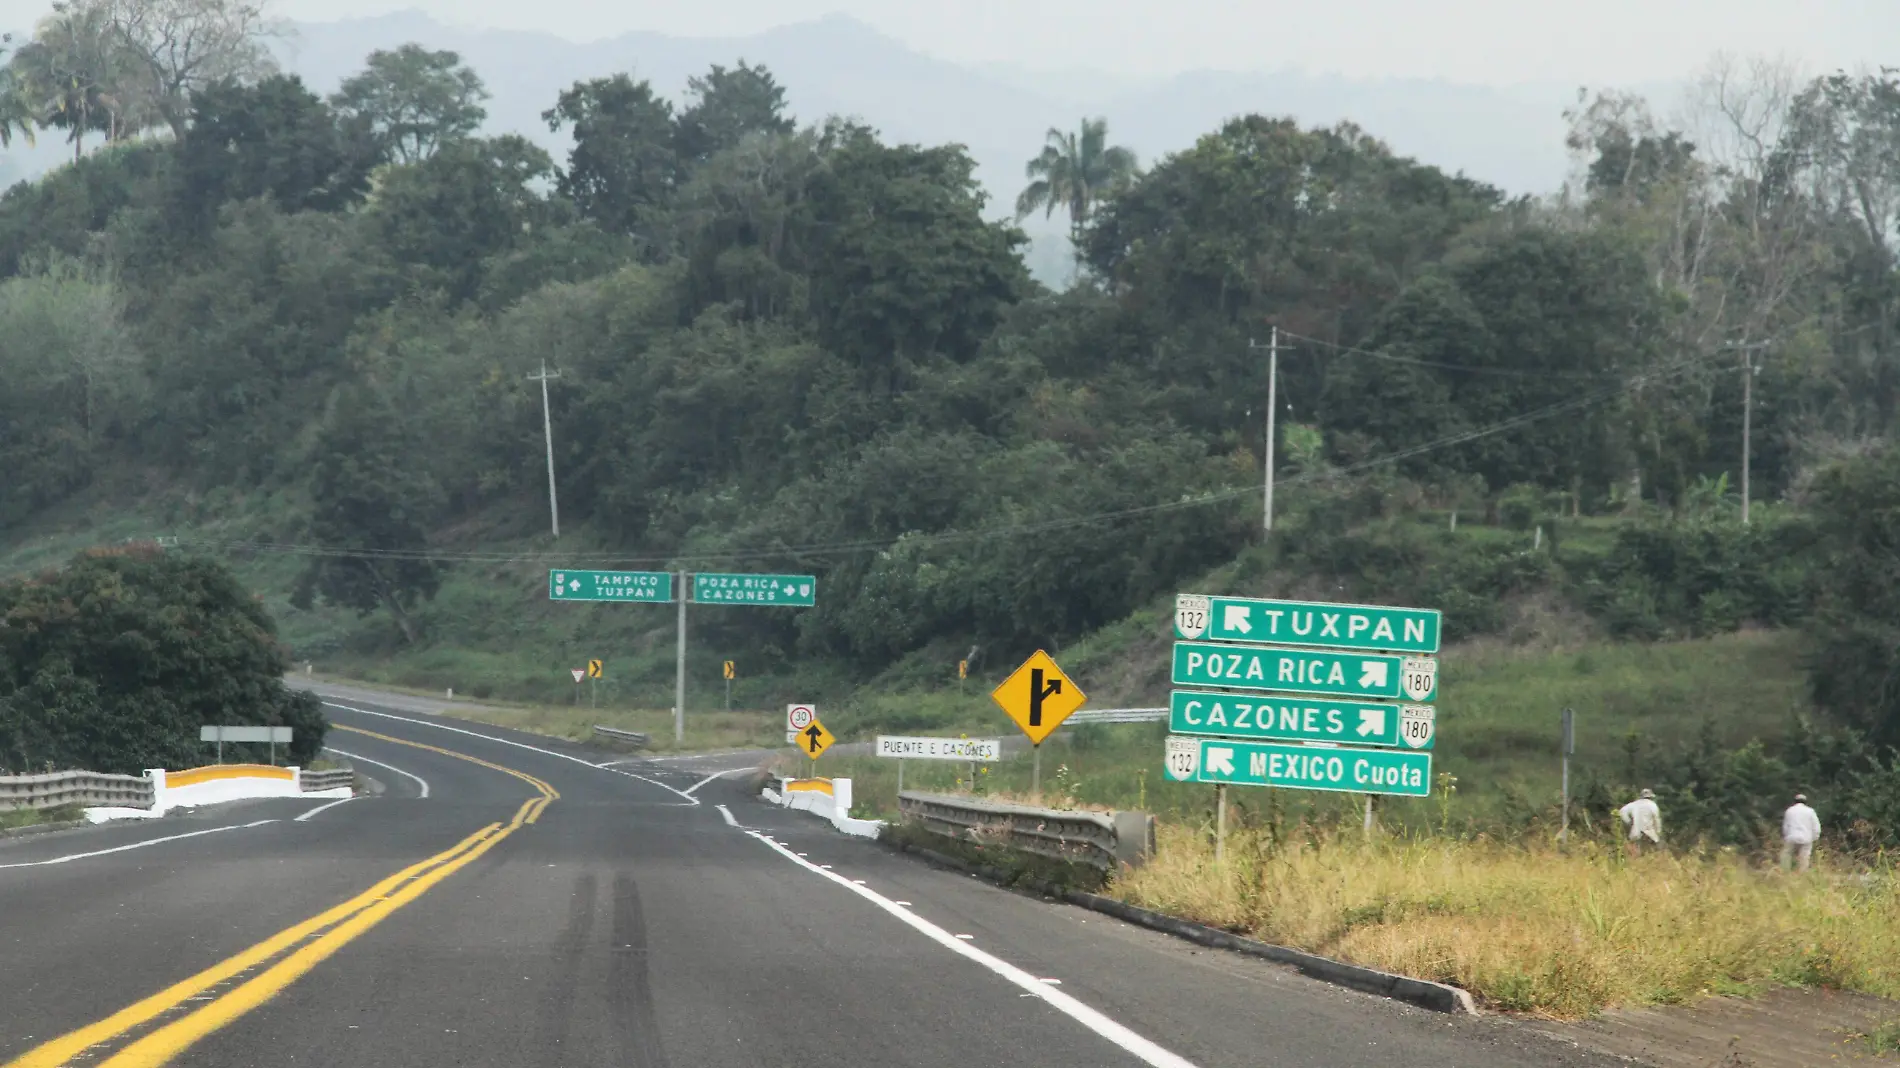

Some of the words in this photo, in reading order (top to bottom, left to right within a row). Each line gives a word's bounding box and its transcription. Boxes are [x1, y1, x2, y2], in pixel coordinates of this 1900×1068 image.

[594, 575, 658, 586] TAMPICO
[699, 577, 739, 588] POZA
[744, 578, 779, 589] RICA
[596, 587, 656, 597] TUXPAN
[702, 590, 775, 600] CAZONES
[1180, 611, 1203, 629] 132
[1265, 610, 1425, 643] TUXPAN
[1187, 652, 1264, 680] POZA
[1278, 658, 1346, 686] RICA
[1408, 674, 1431, 692] 180
[795, 711, 807, 721] 30
[1184, 700, 1344, 734] CAZONES
[1405, 709, 1432, 717] MEXICO
[1406, 721, 1428, 739] 180
[883, 741, 924, 754] PUENTE
[1172, 753, 1192, 773] 132
[1249, 752, 1344, 782] MEXICO
[1354, 758, 1422, 787] Cuota
